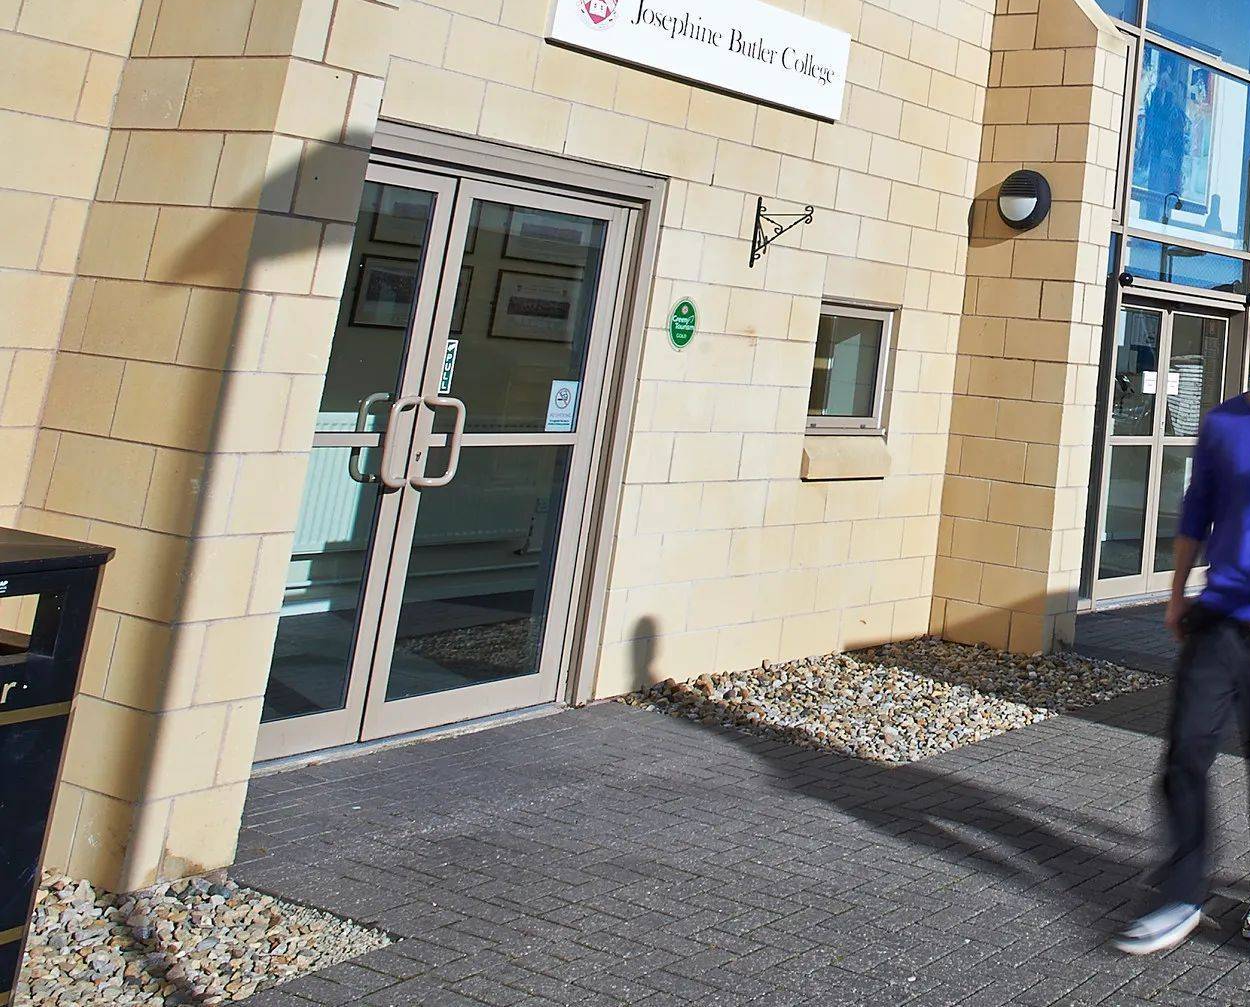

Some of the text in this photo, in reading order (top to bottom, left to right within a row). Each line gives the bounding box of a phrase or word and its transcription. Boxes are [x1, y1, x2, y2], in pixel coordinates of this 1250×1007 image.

[728, 29, 777, 65] Butler
[781, 46, 835, 85] College
[441, 353, 453, 390] PULL
